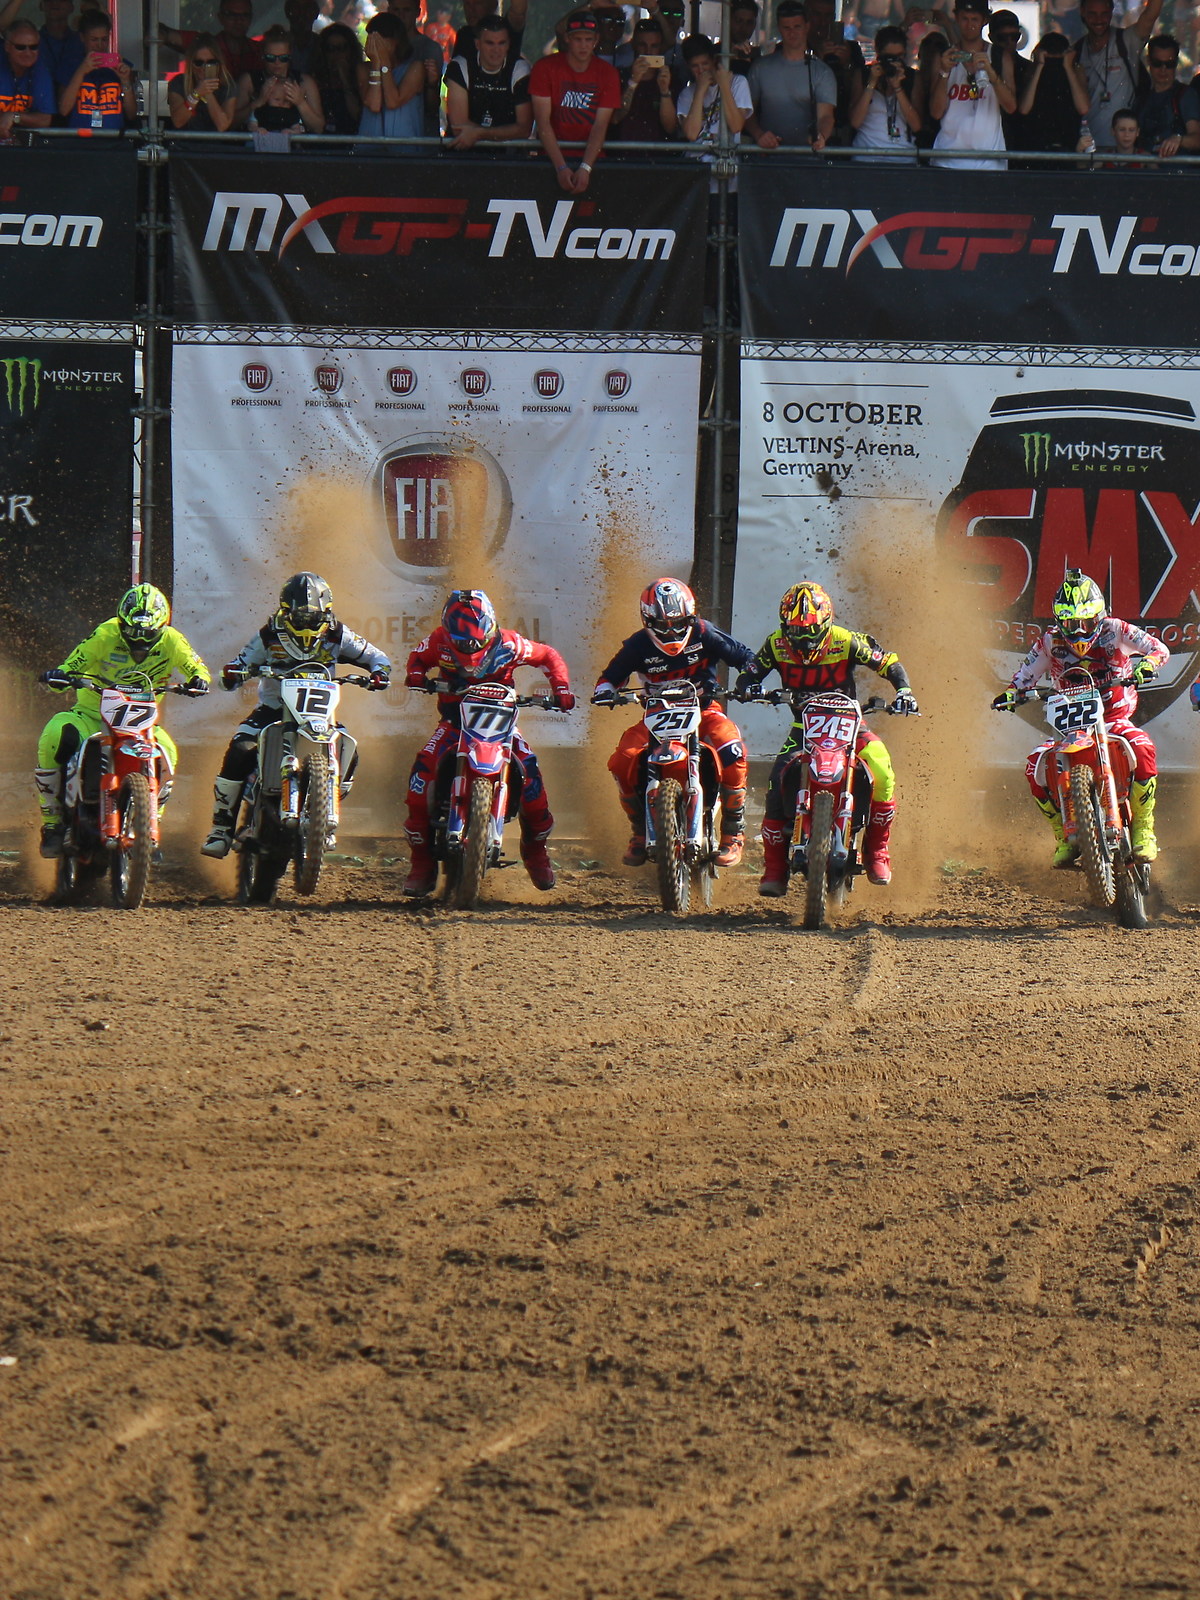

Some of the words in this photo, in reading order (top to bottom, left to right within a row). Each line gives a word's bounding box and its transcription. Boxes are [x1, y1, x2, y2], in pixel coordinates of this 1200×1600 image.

[44, 368, 124, 384] MONSTER
[247, 370, 265, 384] FIAT
[319, 371, 337, 386] FIAT
[391, 373, 411, 388] FIAT
[465, 375, 484, 390] FIAT
[538, 376, 558, 390] FIAT
[609, 376, 626, 390] FIAT
[55, 385, 112, 393] ENERGY
[231, 398, 282, 407] PROFESSIONAL
[375, 402, 426, 410] PROFESSIONAL
[522, 405, 571, 413] PROFESSIONAL
[593, 405, 639, 413] PROFESSIONAL
[762, 402, 774, 423] 8
[783, 402, 923, 426] OCTOBER
[762, 437, 920, 459] VELTINS-Arena,
[1055, 441, 1166, 461] MONSTER
[763, 459, 853, 480] Germany
[1071, 464, 1149, 473] ENERGY
[396, 477, 462, 541] FIA
[786, 663, 846, 689] FOX
[295, 687, 331, 715] 12
[104, 703, 156, 728] 17
[467, 706, 514, 732] 777
[652, 711, 694, 735] 251
[1054, 701, 1099, 731] 222
[805, 715, 856, 742] 243
